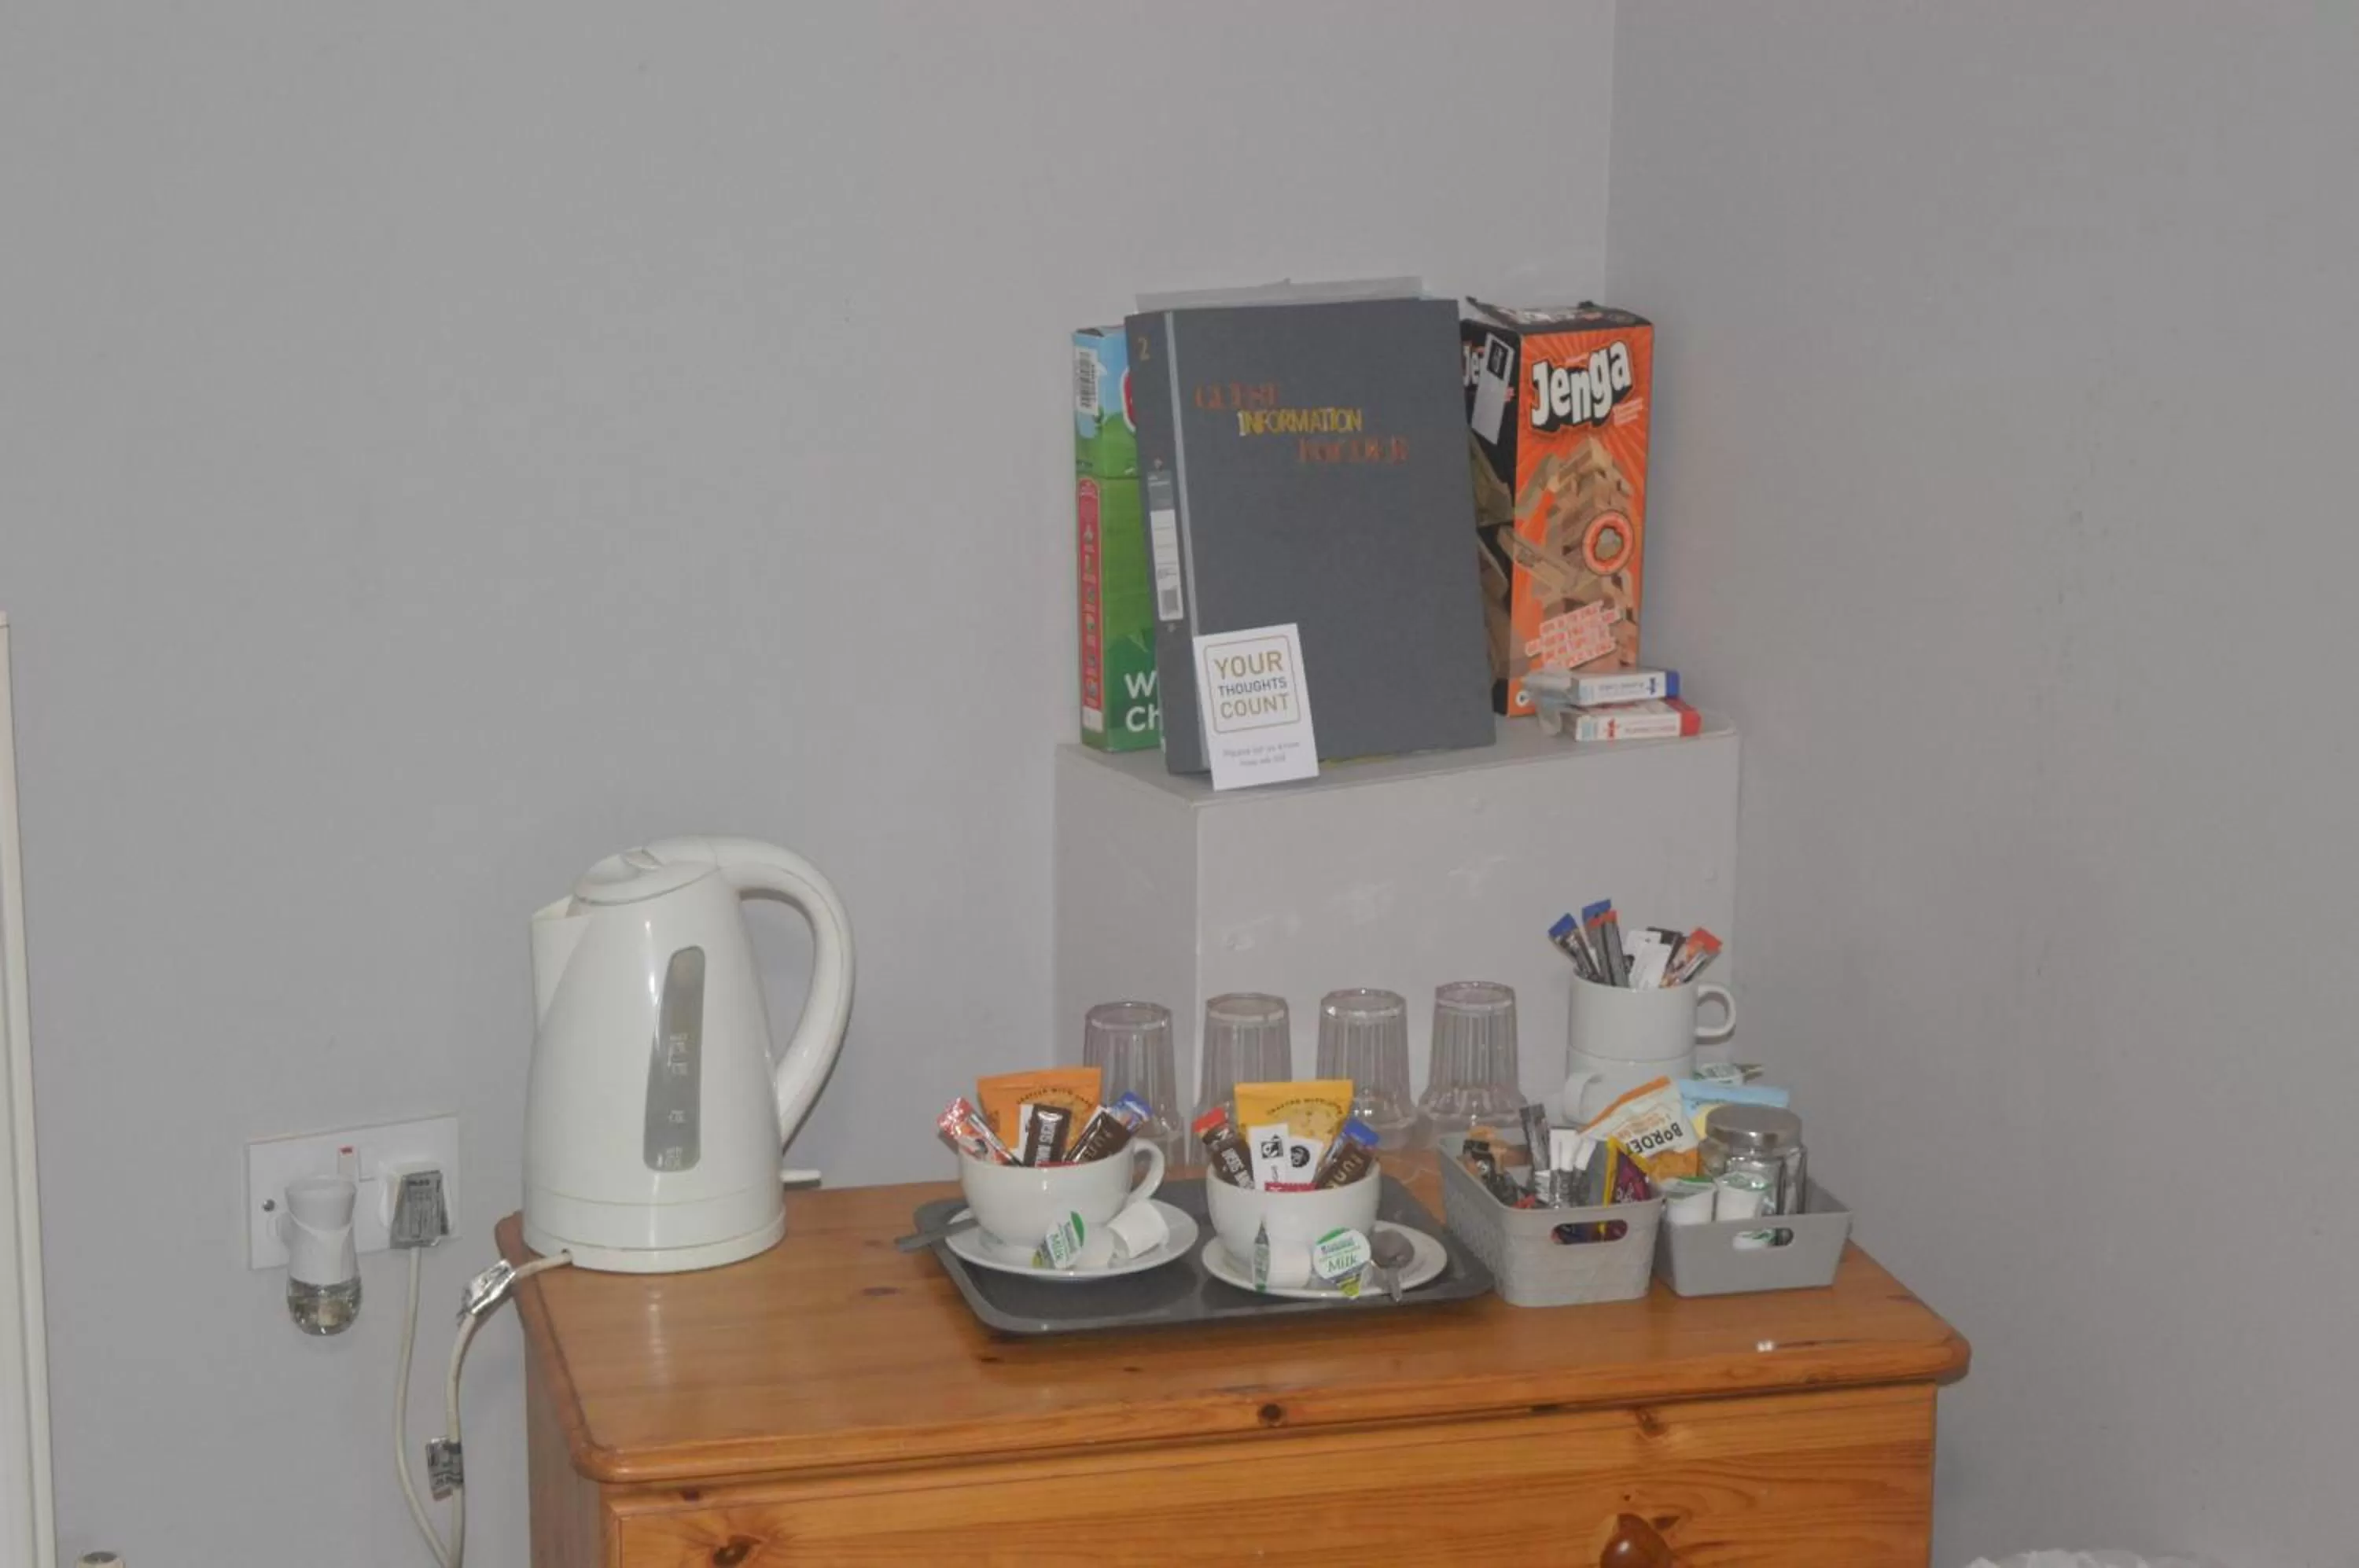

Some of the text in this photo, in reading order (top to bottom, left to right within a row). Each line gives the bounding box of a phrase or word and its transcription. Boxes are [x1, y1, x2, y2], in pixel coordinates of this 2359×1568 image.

[1531, 340, 1632, 426] Jenga
[1237, 407, 1363, 437] INFORMATION
[1214, 650, 1284, 680] YOUR
[1217, 676, 1288, 697] THOUGHTS
[1220, 693, 1290, 720] COUNT
[1327, 1252, 1357, 1273] Milk
